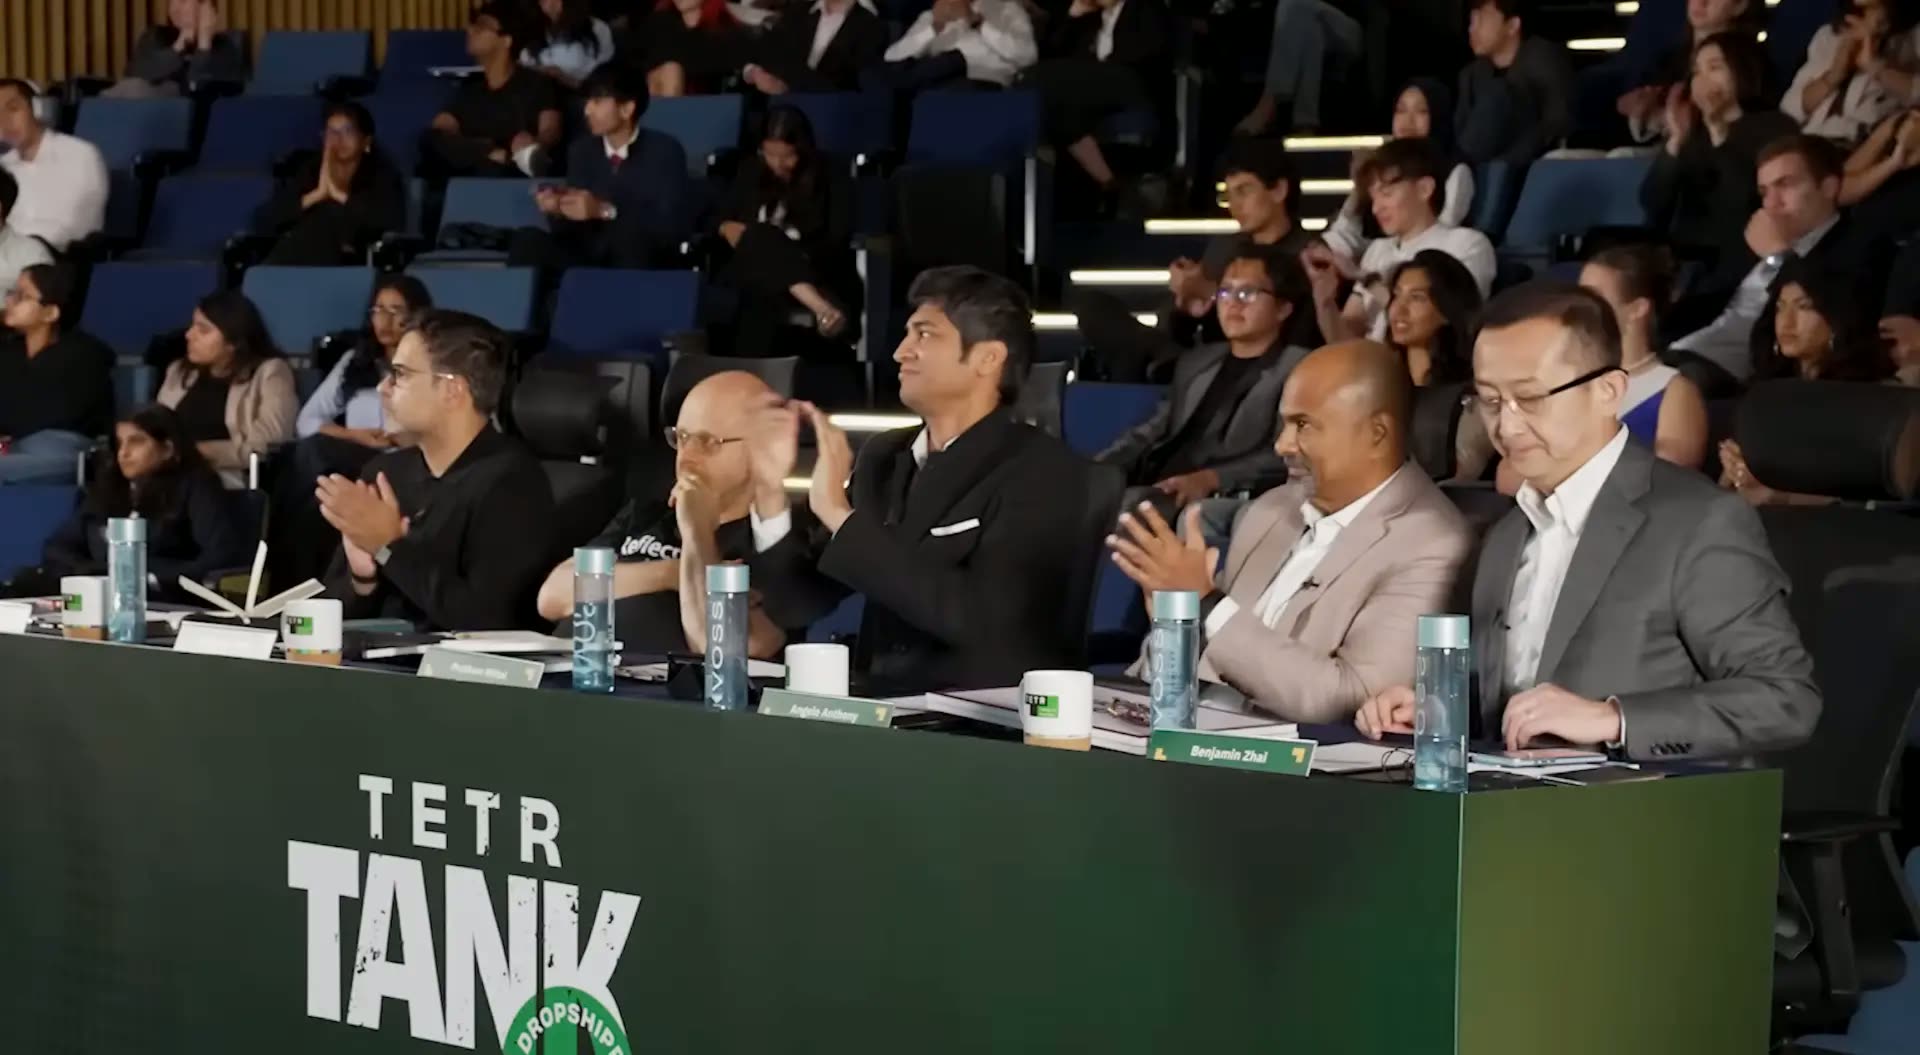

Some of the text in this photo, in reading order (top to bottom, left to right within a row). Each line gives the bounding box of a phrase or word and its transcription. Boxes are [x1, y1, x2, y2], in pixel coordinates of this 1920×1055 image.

[712, 601, 724, 691] VOSS
[1190, 745, 1241, 761] Benjamin
[359, 774, 562, 868] TETR
[288, 839, 641, 1051] TANK
